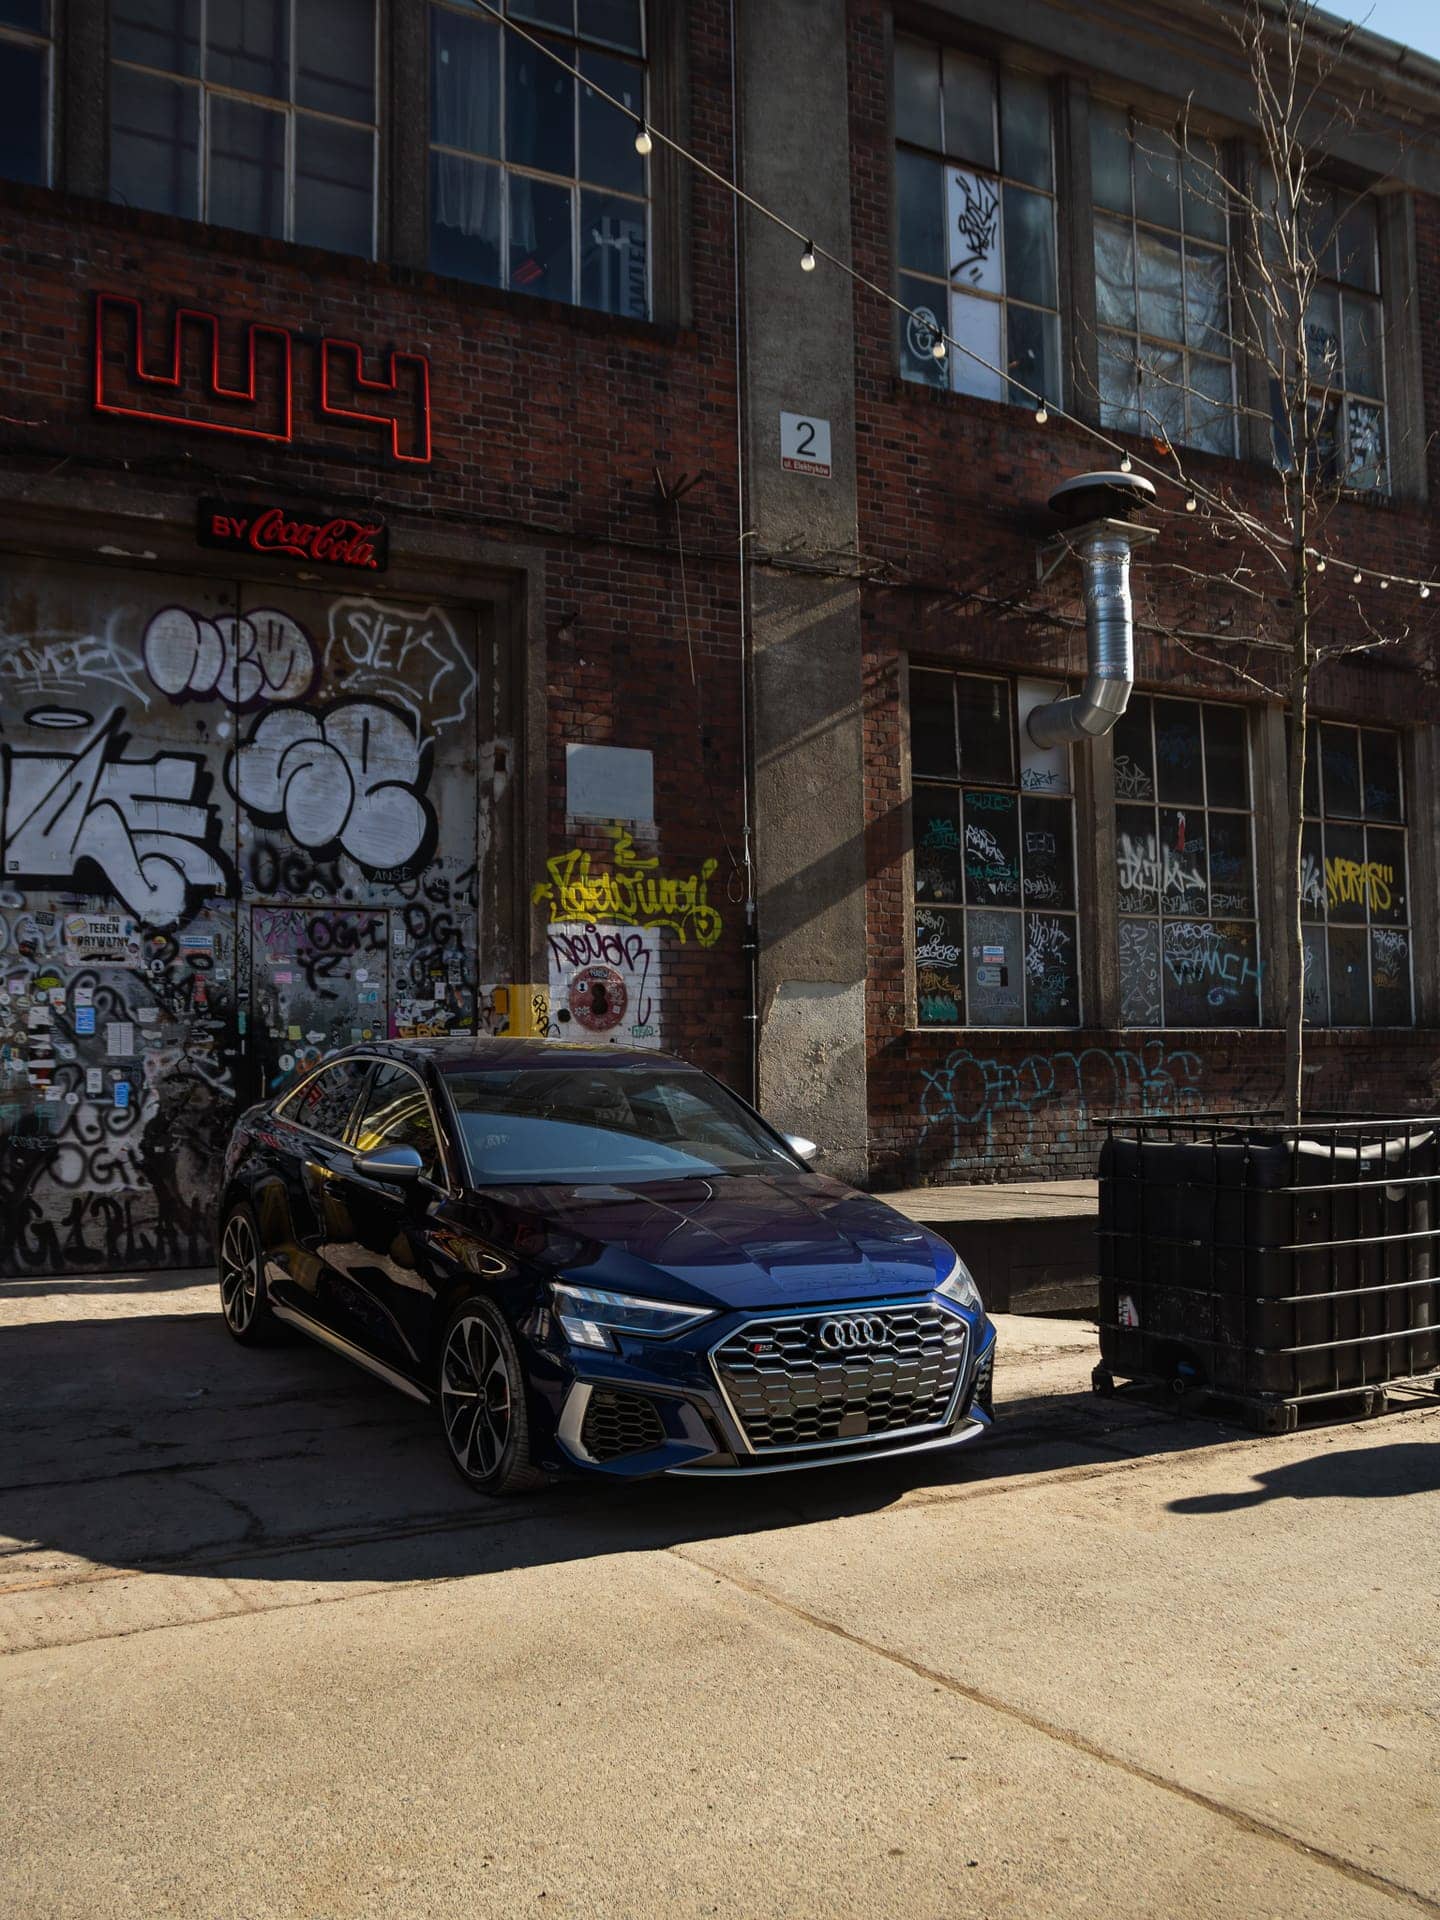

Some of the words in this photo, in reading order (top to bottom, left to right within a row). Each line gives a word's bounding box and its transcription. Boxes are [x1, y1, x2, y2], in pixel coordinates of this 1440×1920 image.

[796, 421, 816, 458] 2
[211, 515, 246, 539] BY
[89, 922, 119, 934] TEREN
